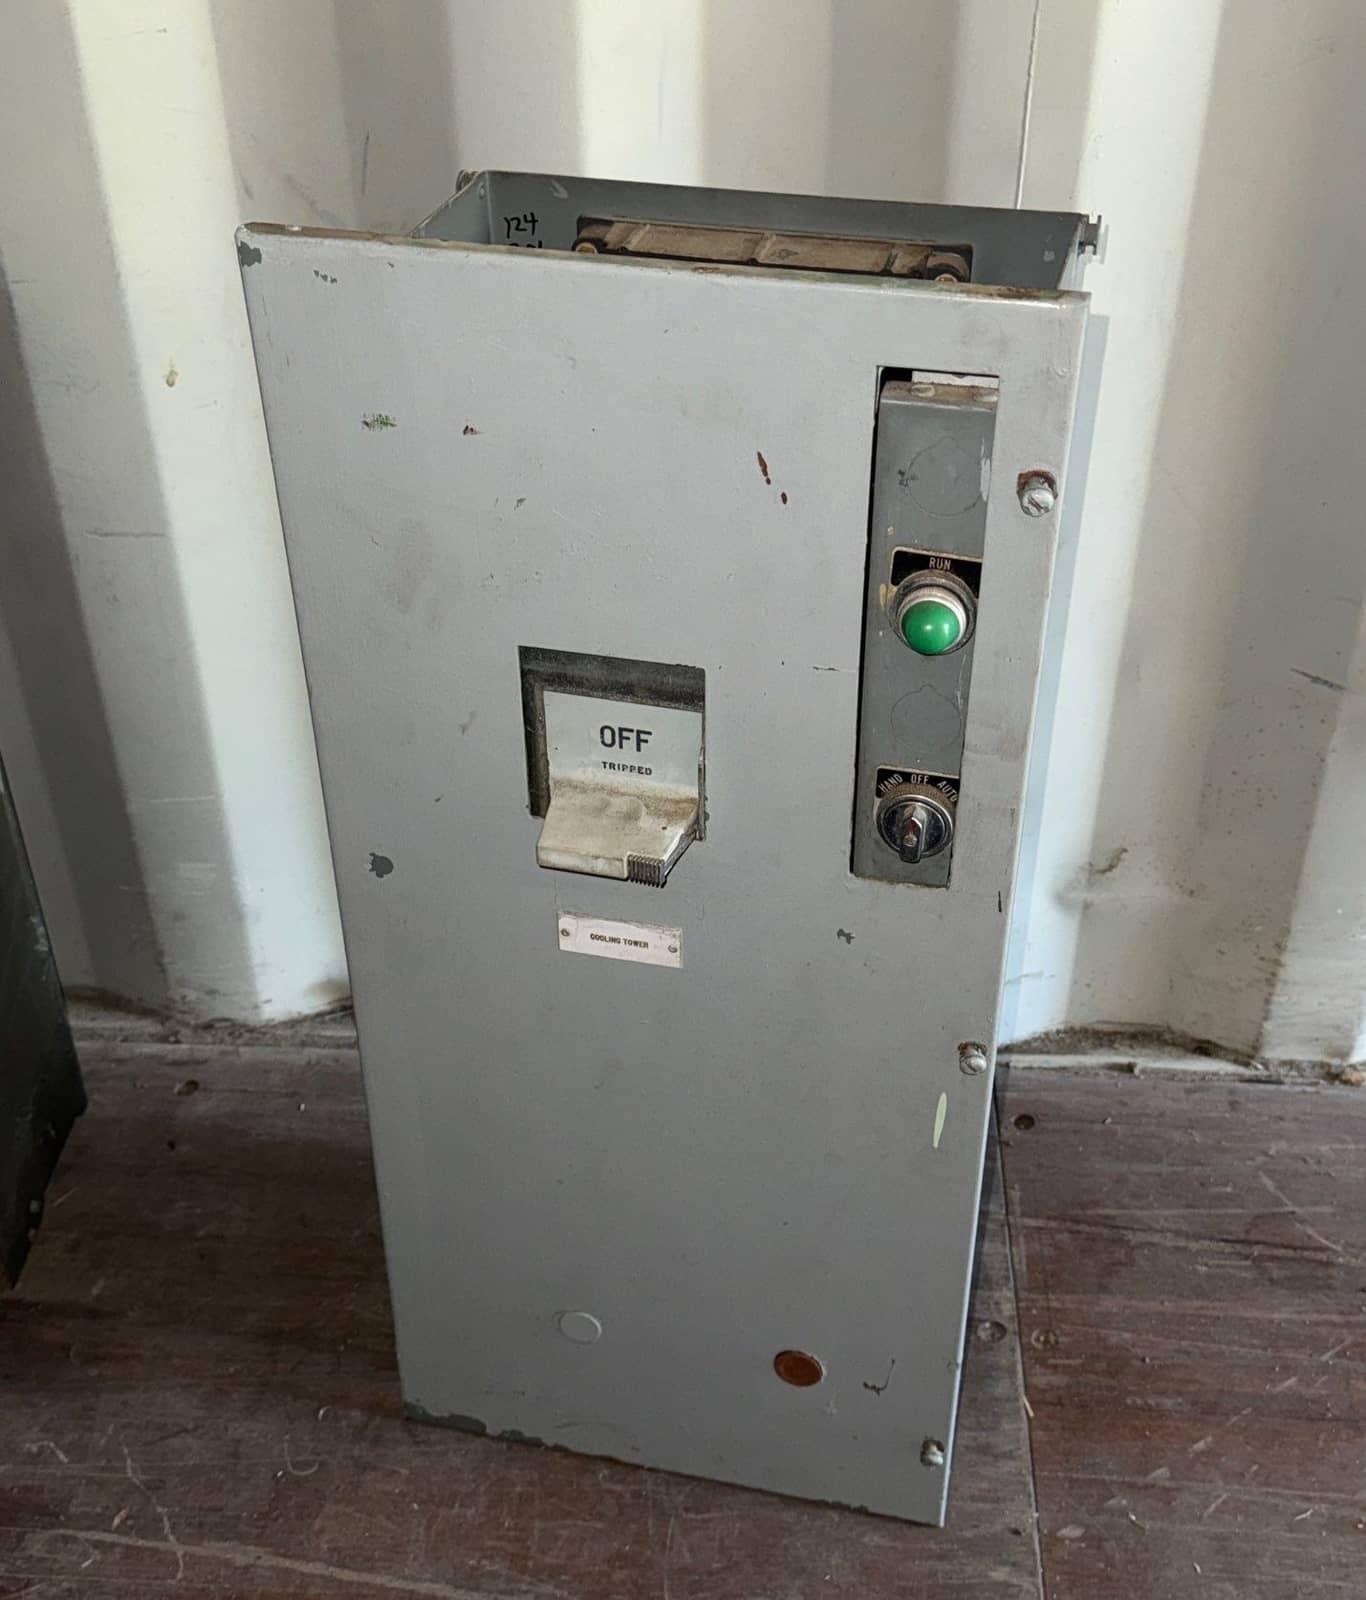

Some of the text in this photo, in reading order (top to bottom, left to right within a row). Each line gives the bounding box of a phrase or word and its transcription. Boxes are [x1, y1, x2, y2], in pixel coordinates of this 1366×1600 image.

[928, 556, 952, 570] RUN
[600, 725, 653, 752] OFF
[601, 761, 653, 776] TRIPPED
[878, 773, 904, 793] HAND
[910, 774, 930, 784] OFF
[590, 933, 649, 949] COOLING TOWER
